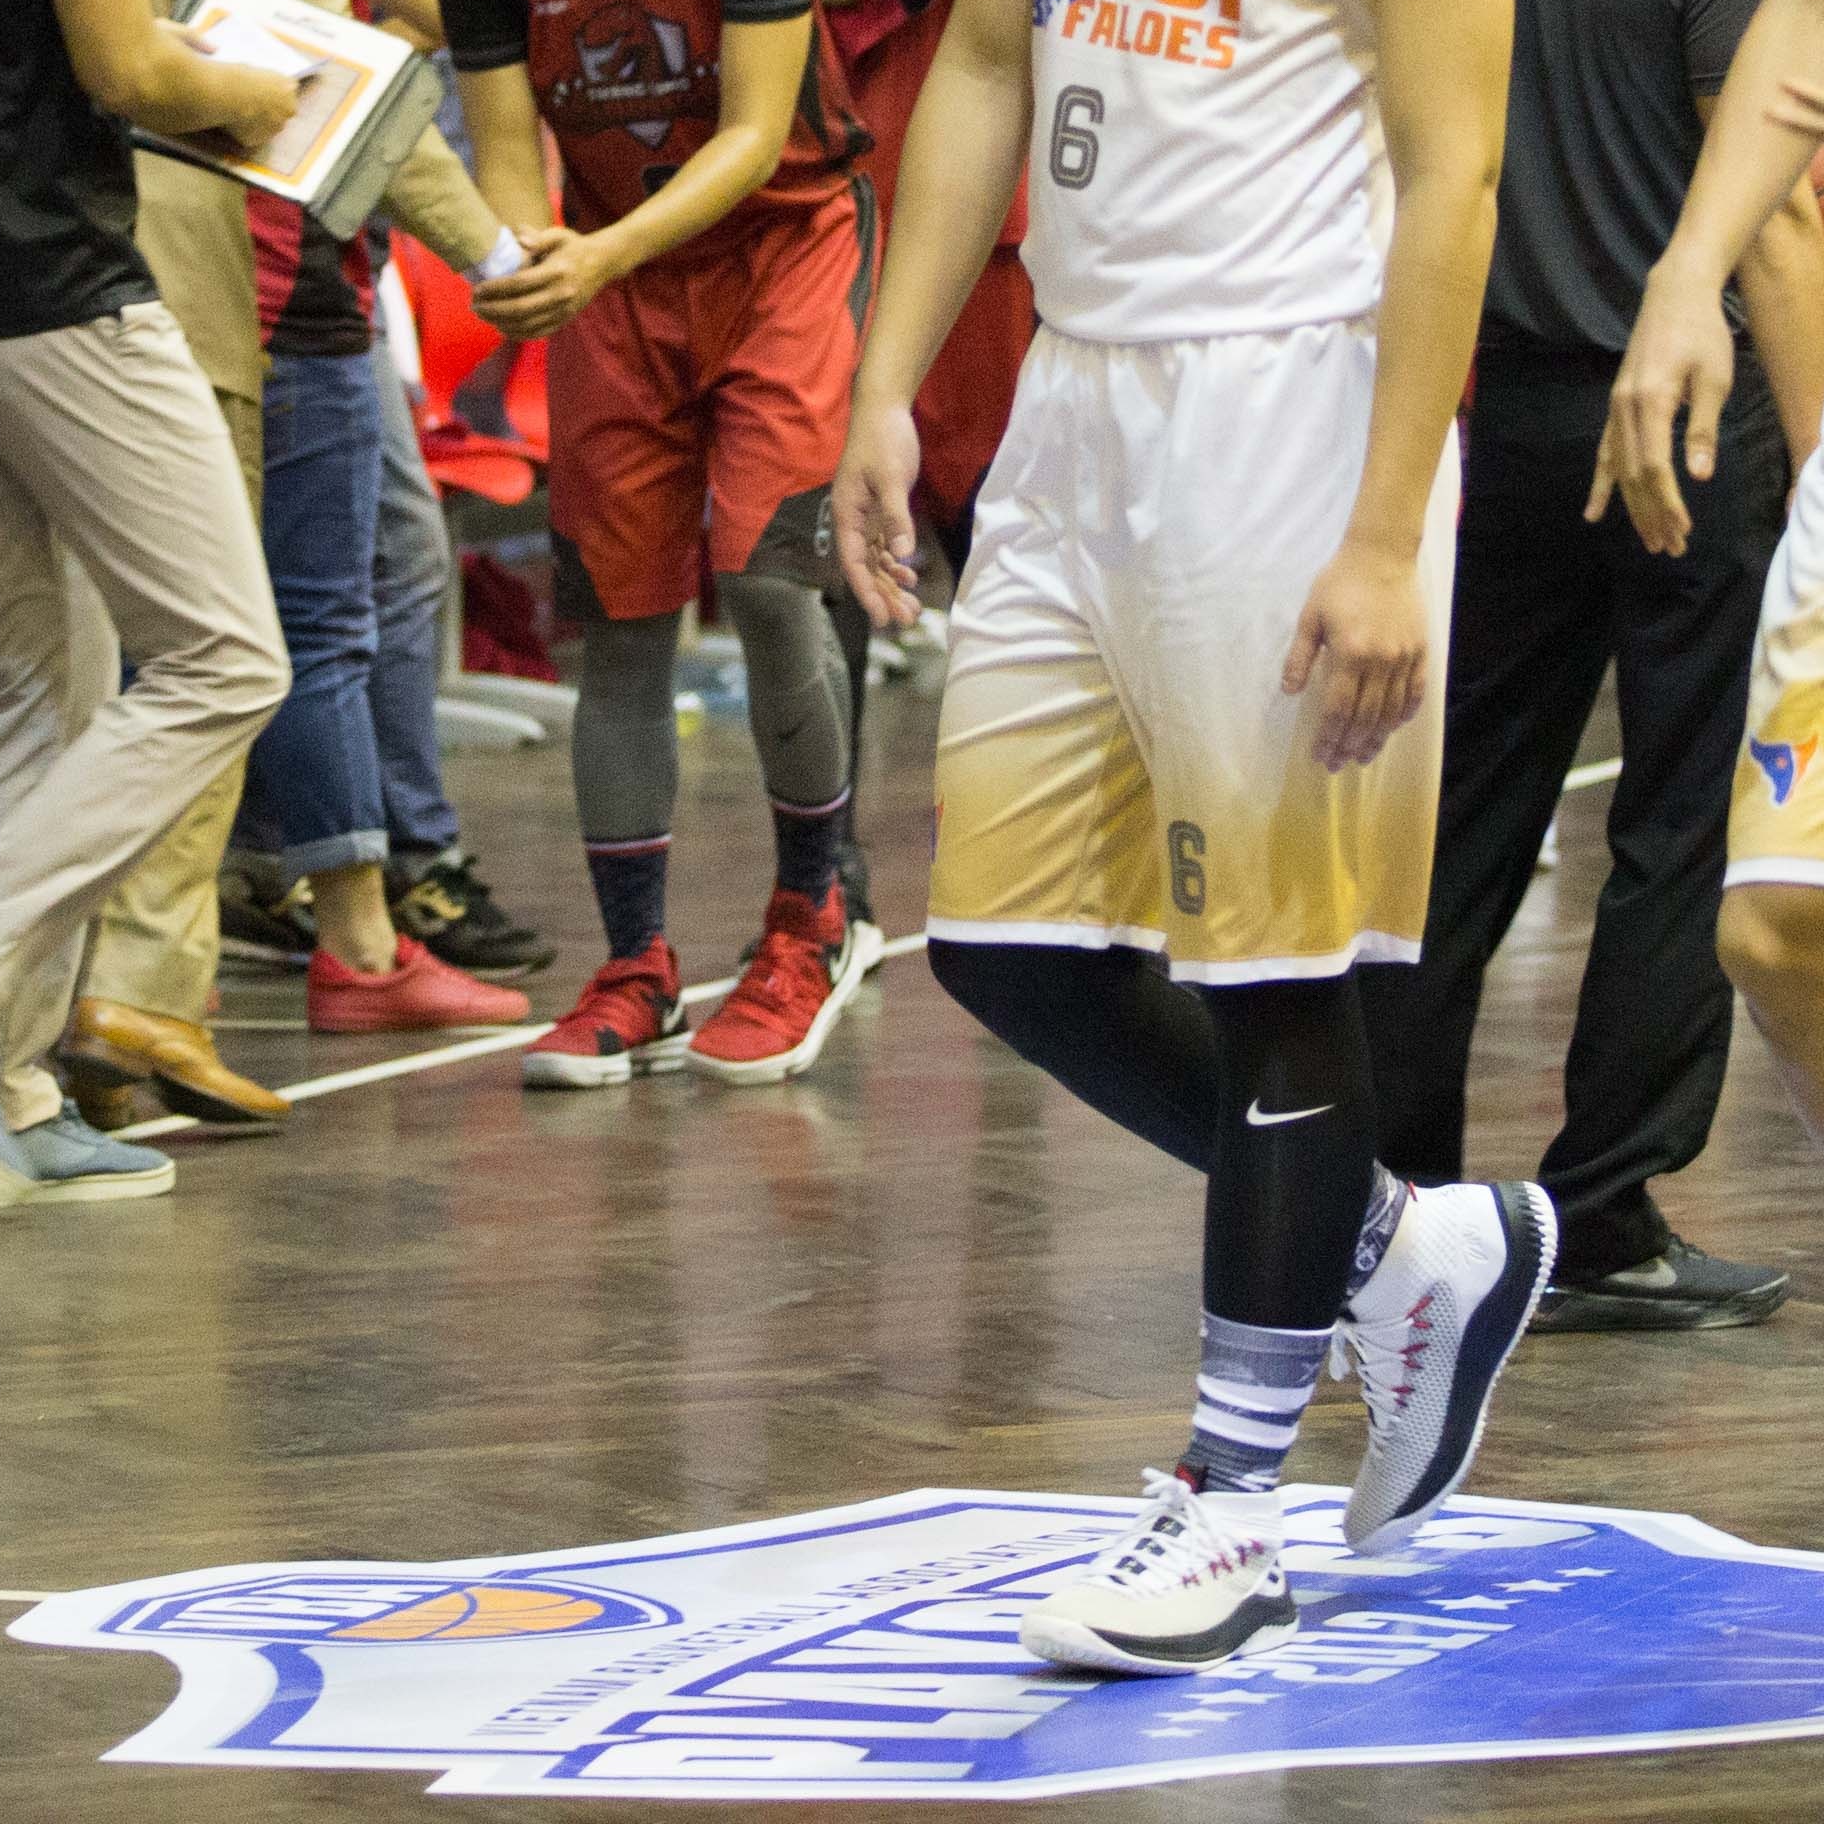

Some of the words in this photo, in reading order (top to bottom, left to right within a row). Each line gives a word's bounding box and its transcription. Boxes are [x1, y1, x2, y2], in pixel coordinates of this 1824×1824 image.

[1049, 84, 1105, 191] 6
[1167, 819, 1208, 916] 6
[156, 1579, 459, 1633] VBA
[574, 1511, 1596, 1779] PLAYOFS
[470, 1679, 639, 1735] VIETNAM
[589, 1602, 852, 1675] BASKETBALL
